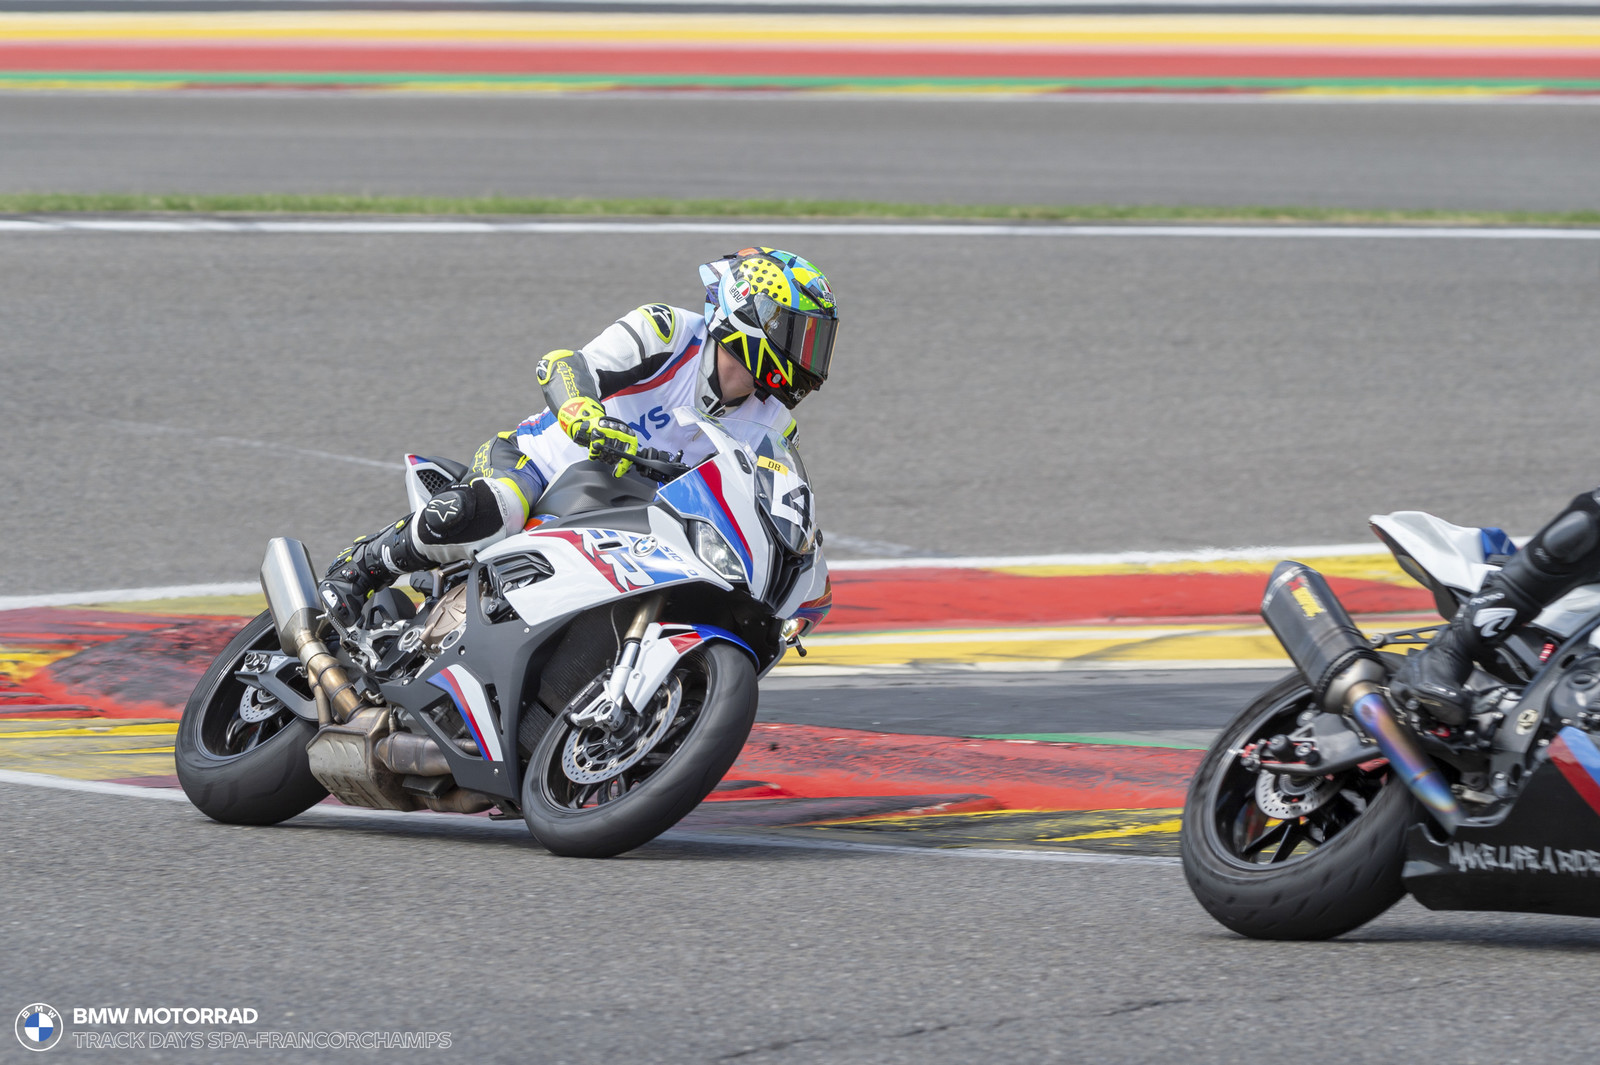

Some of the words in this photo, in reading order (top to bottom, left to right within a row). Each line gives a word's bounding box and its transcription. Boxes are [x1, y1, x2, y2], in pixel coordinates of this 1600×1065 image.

[767, 460, 781, 472] DB
[1499, 845, 1541, 870] LIFE
[1541, 846, 1558, 874] A
